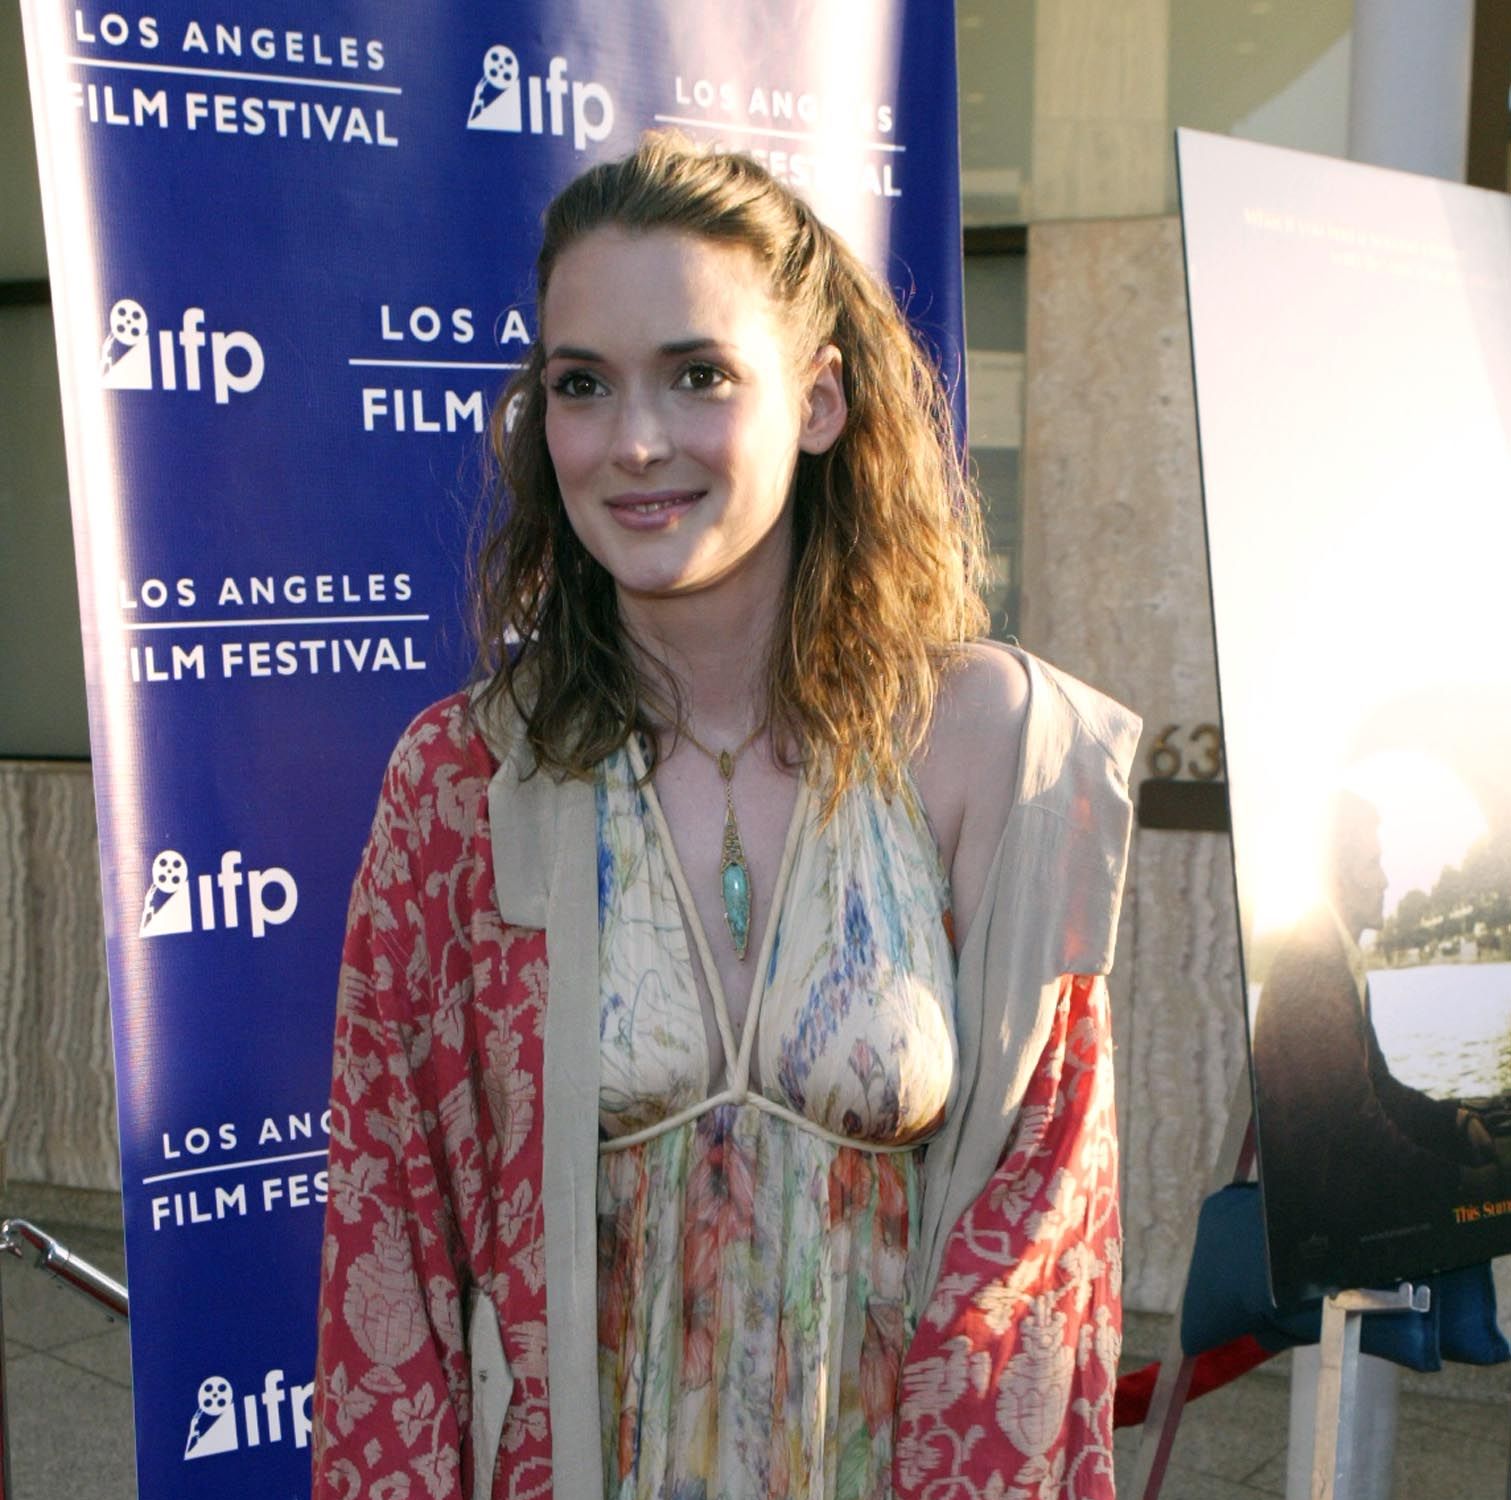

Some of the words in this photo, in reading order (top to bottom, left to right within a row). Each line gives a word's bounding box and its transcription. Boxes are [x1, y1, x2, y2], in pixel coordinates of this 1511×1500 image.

[75, 9, 159, 49] LOS
[182, 21, 385, 71] ANGELES
[186, 92, 399, 147] FESTIVAL
[528, 56, 615, 150] ifp
[675, 76, 737, 111] LOS
[748, 87, 893, 133] ANGS
[381, 304, 475, 344] LOS
[159, 306, 265, 404] ifp
[362, 387, 484, 433] FILM
[119, 577, 197, 609] LOS
[218, 573, 412, 606] ANGELES
[130, 644, 206, 682] ILM
[222, 636, 427, 678] FESTIVAL
[199, 850, 298, 938] ifp
[163, 1123, 238, 1160] LOS
[151, 1184, 247, 1231] FILM
